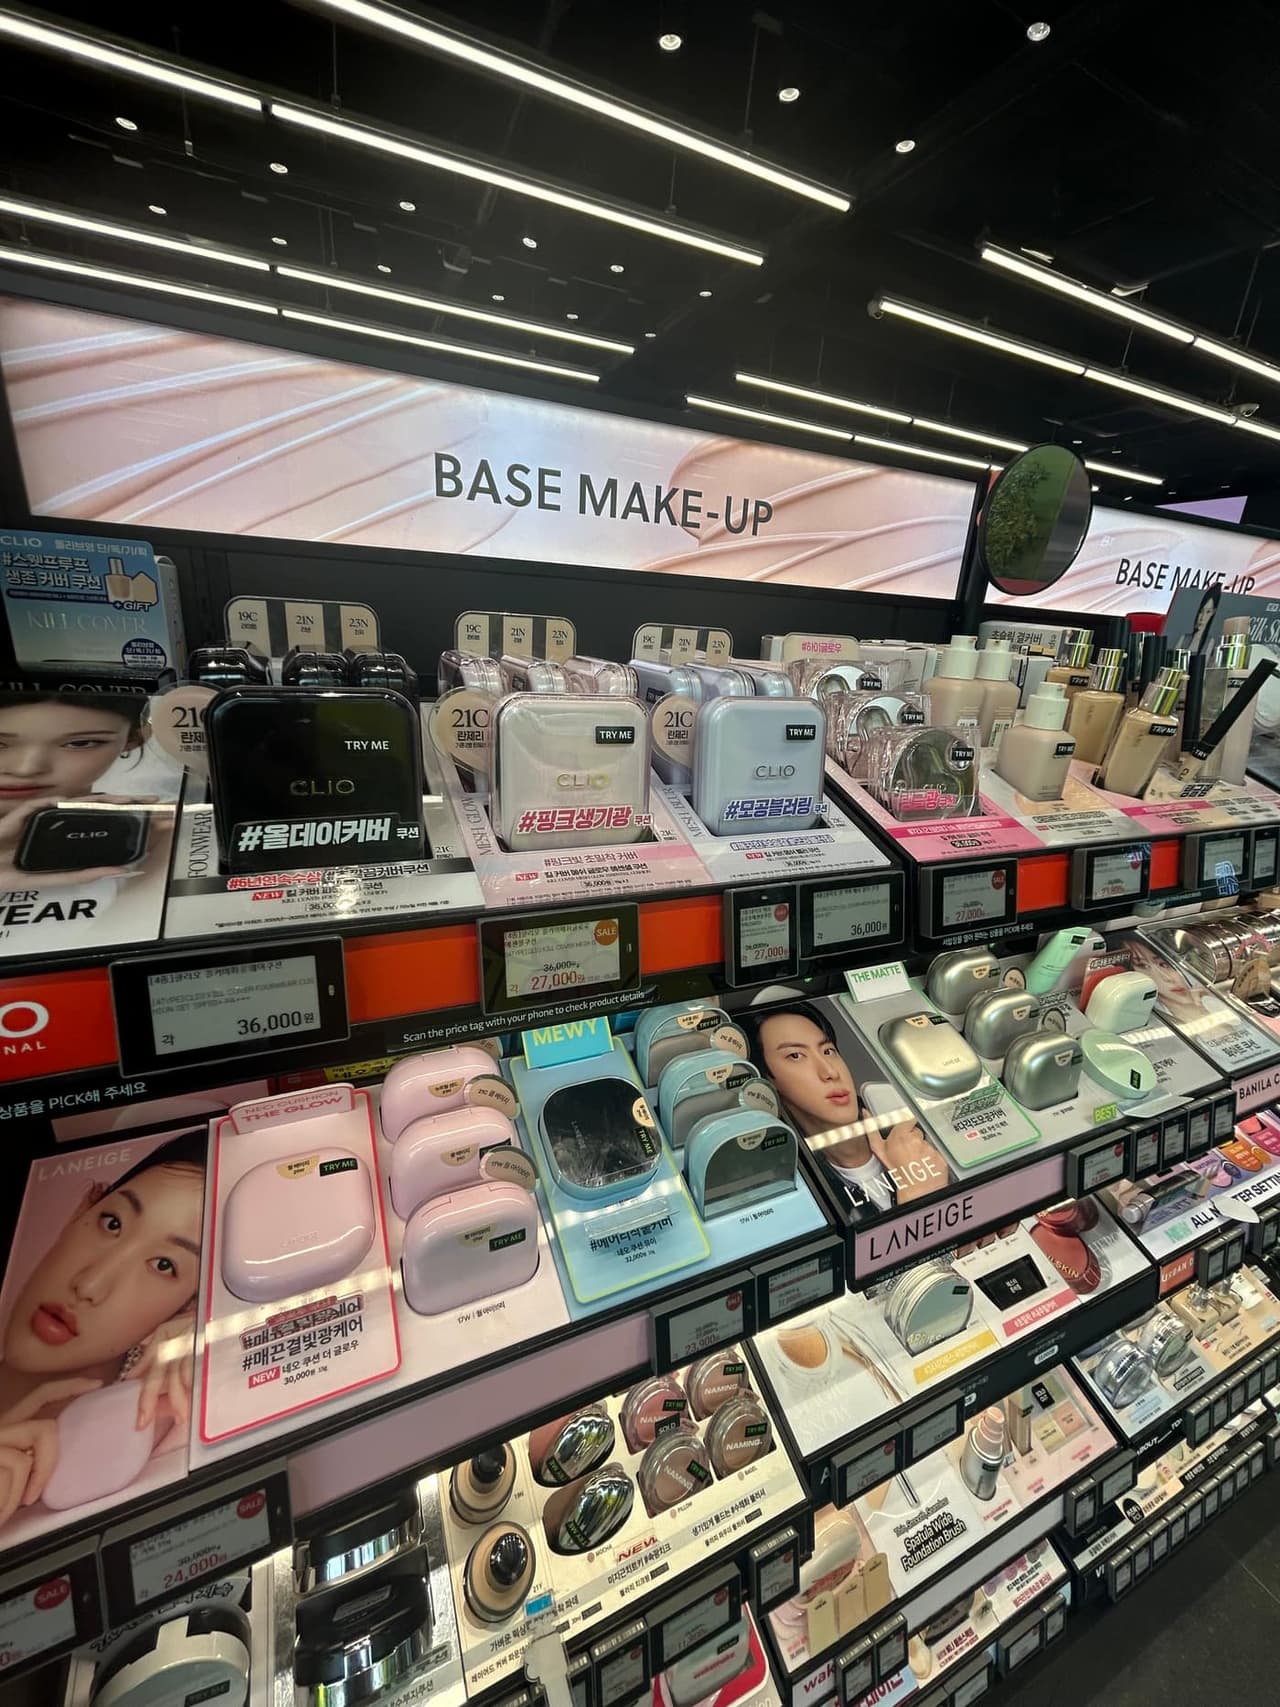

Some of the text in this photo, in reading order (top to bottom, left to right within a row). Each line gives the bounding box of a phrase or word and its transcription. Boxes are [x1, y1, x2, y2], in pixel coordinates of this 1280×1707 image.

[434, 451, 774, 536] BASE MAKE-UP
[0, 536, 42, 547] CLIO
[6, 569, 103, 590] 생존 커버 쿠션
[1116, 558, 1169, 590] BASE
[238, 611, 258, 622] 19C
[295, 615, 314, 625] 21N
[348, 617, 369, 628] 23N
[465, 623, 482, 633] 19C
[510, 627, 526, 637] 21N
[552, 629, 568, 639] 23N
[452, 709, 489, 728] 21C
[664, 711, 693, 728] 21C
[457, 730, 485, 742] 란제리
[599, 731, 633, 740] TRY ME
[667, 729, 689, 740] 란제리
[788, 728, 814, 737] TRY ME
[344, 740, 390, 751] TRY ME
[755, 765, 796, 779] CLIO
[289, 779, 355, 796] CLIO
[556, 773, 609, 791] CLIO
[725, 797, 828, 820] #모공블러링 쿠션
[518, 806, 651, 833] #핑크생기광 쿠션
[66, 830, 109, 840] CLIO
[237, 817, 420, 852] #올데이커버 쿠션
[187, 810, 214, 879] FOUNWEAR
[617, 851, 639, 861] 커버
[227, 872, 321, 890] #6년연속수상
[515, 873, 539, 881] NEW
[554, 869, 571, 878] 커버
[254, 890, 283, 900] NEW
[299, 886, 321, 896] 커버
[362, 881, 384, 891] 쿠션
[0, 899, 97, 926] EAR
[594, 927, 617, 938] SALE
[851, 964, 901, 983] THE MATTE
[403, 991, 645, 1043] Scan the price tag with your phone to check product details
[161, 1010, 314, 1046] 각 36,000원
[532, 1017, 598, 1046] MEWY
[1239, 1077, 1273, 1099] BANILA
[0, 1081, 148, 1121] 상품을 P!CK해 주세요
[241, 1095, 344, 1122] THE GLOW
[244, 1090, 339, 1114] NEO CUSHION
[1094, 1105, 1117, 1121] BEST
[38, 1148, 131, 1182] LANEIGE
[323, 1161, 339, 1172] TRY
[340, 1160, 356, 1169] ME
[843, 1156, 942, 1208] LANEIGE
[1191, 1209, 1212, 1229] ALL
[870, 1196, 975, 1261] LANEIGE
[242, 1315, 364, 1371] #매끈결빛광케어
[282, 1338, 360, 1373] 네오 쿠션 더 글로우
[252, 1369, 277, 1385] NEW
[658, 1421, 677, 1436] SOLD
[904, 1524, 933, 1552] Spatula
[932, 1512, 954, 1534] Wide
[902, 1520, 967, 1571] Foundation Brush
[40, 1586, 68, 1603] SALE
